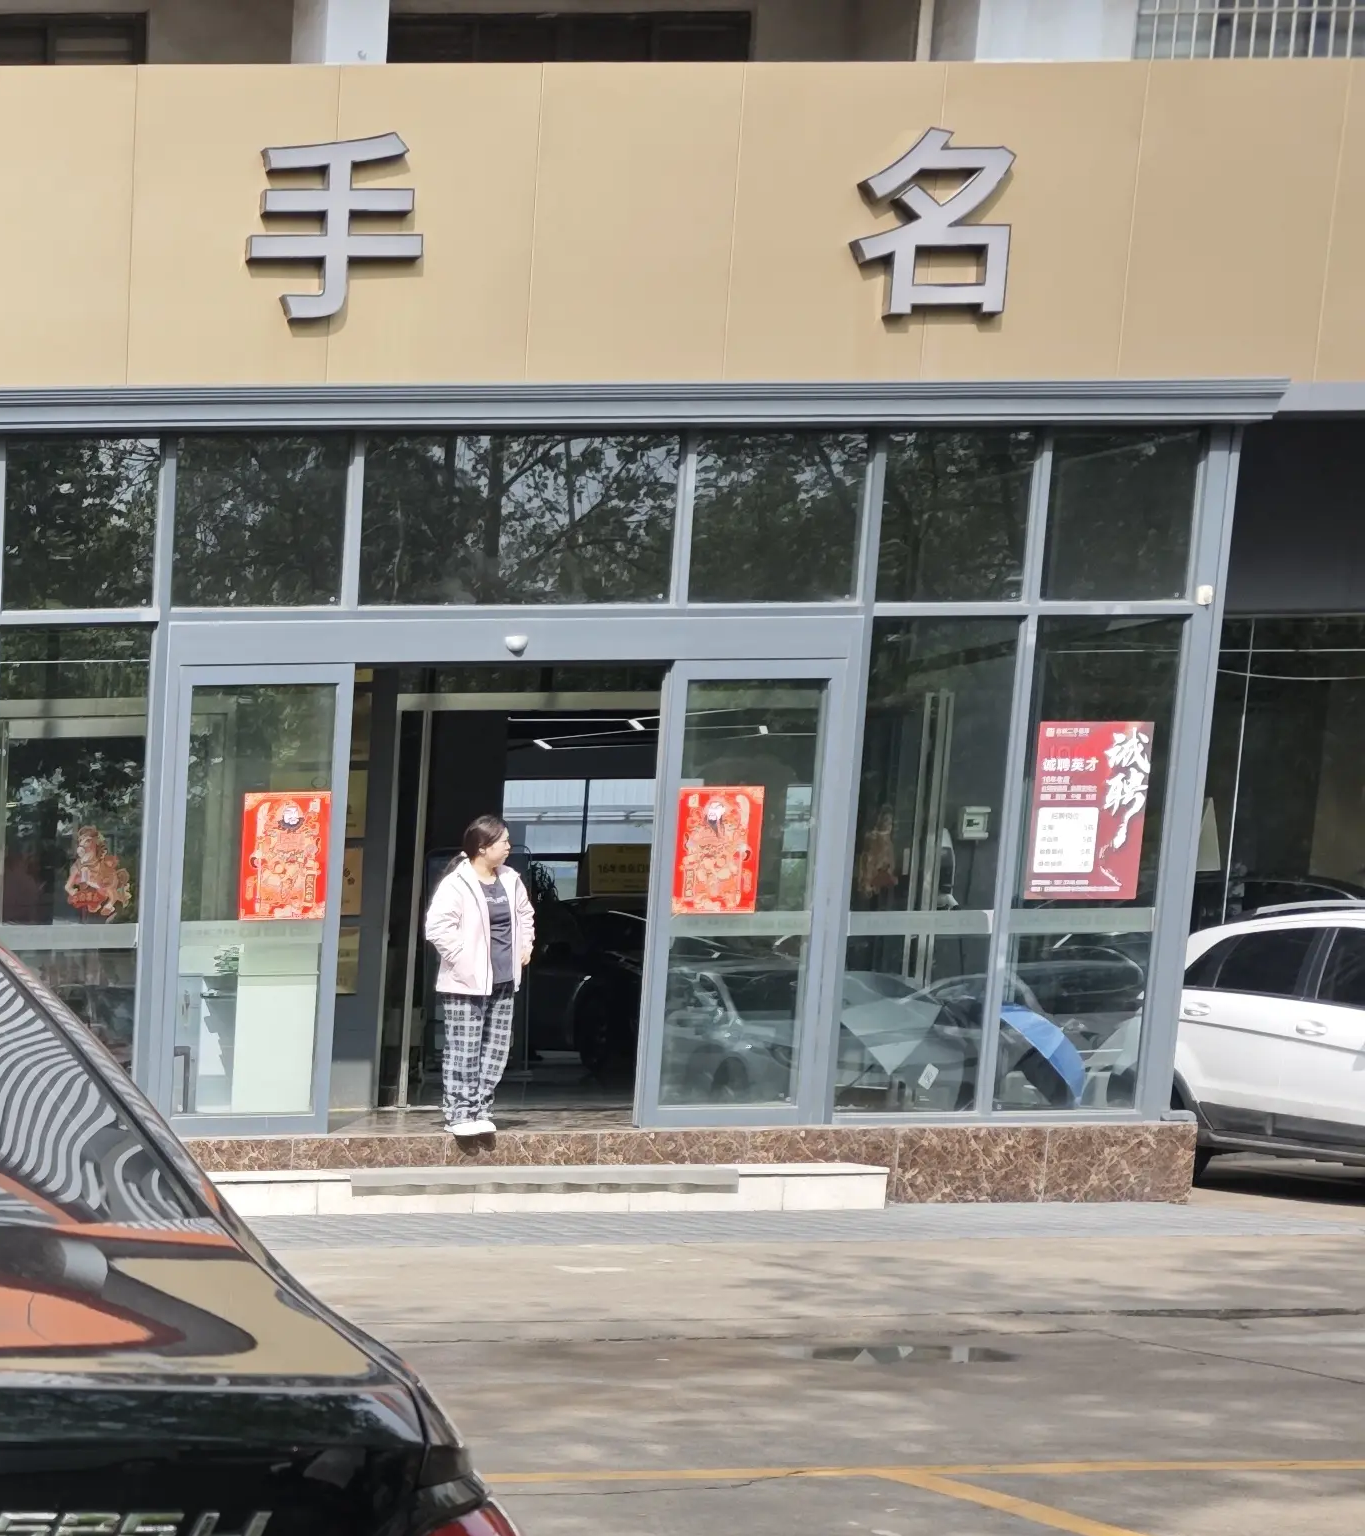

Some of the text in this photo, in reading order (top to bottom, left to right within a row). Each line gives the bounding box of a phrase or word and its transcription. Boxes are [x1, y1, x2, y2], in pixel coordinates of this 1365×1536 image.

[1042, 757, 1099, 772] 诚聘英才
[1103, 727, 1151, 849] 诚聘
